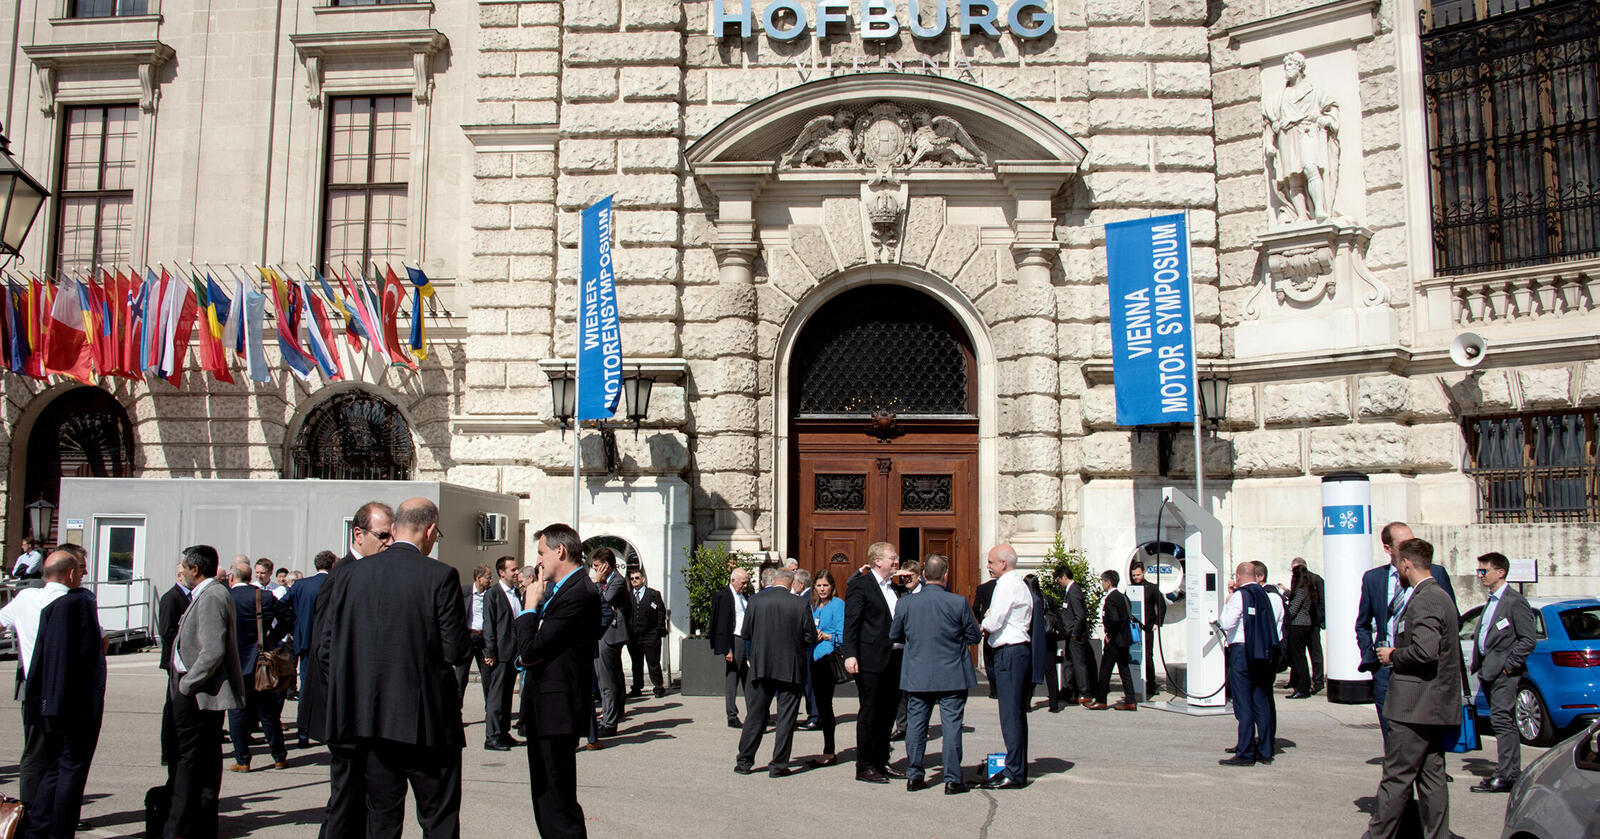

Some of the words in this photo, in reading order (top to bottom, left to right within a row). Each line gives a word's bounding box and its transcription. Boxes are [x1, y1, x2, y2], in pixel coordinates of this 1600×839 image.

[713, 0, 1055, 41] HOFBURG
[791, 54, 975, 73] VIENNA
[584, 277, 599, 351] WIENER
[598, 207, 622, 409] MOTORENSYMPOSIUM
[1151, 223, 1184, 336] SYMPOSIUM
[1124, 287, 1153, 360] VIENNA
[1158, 343, 1189, 414] MOTOR
